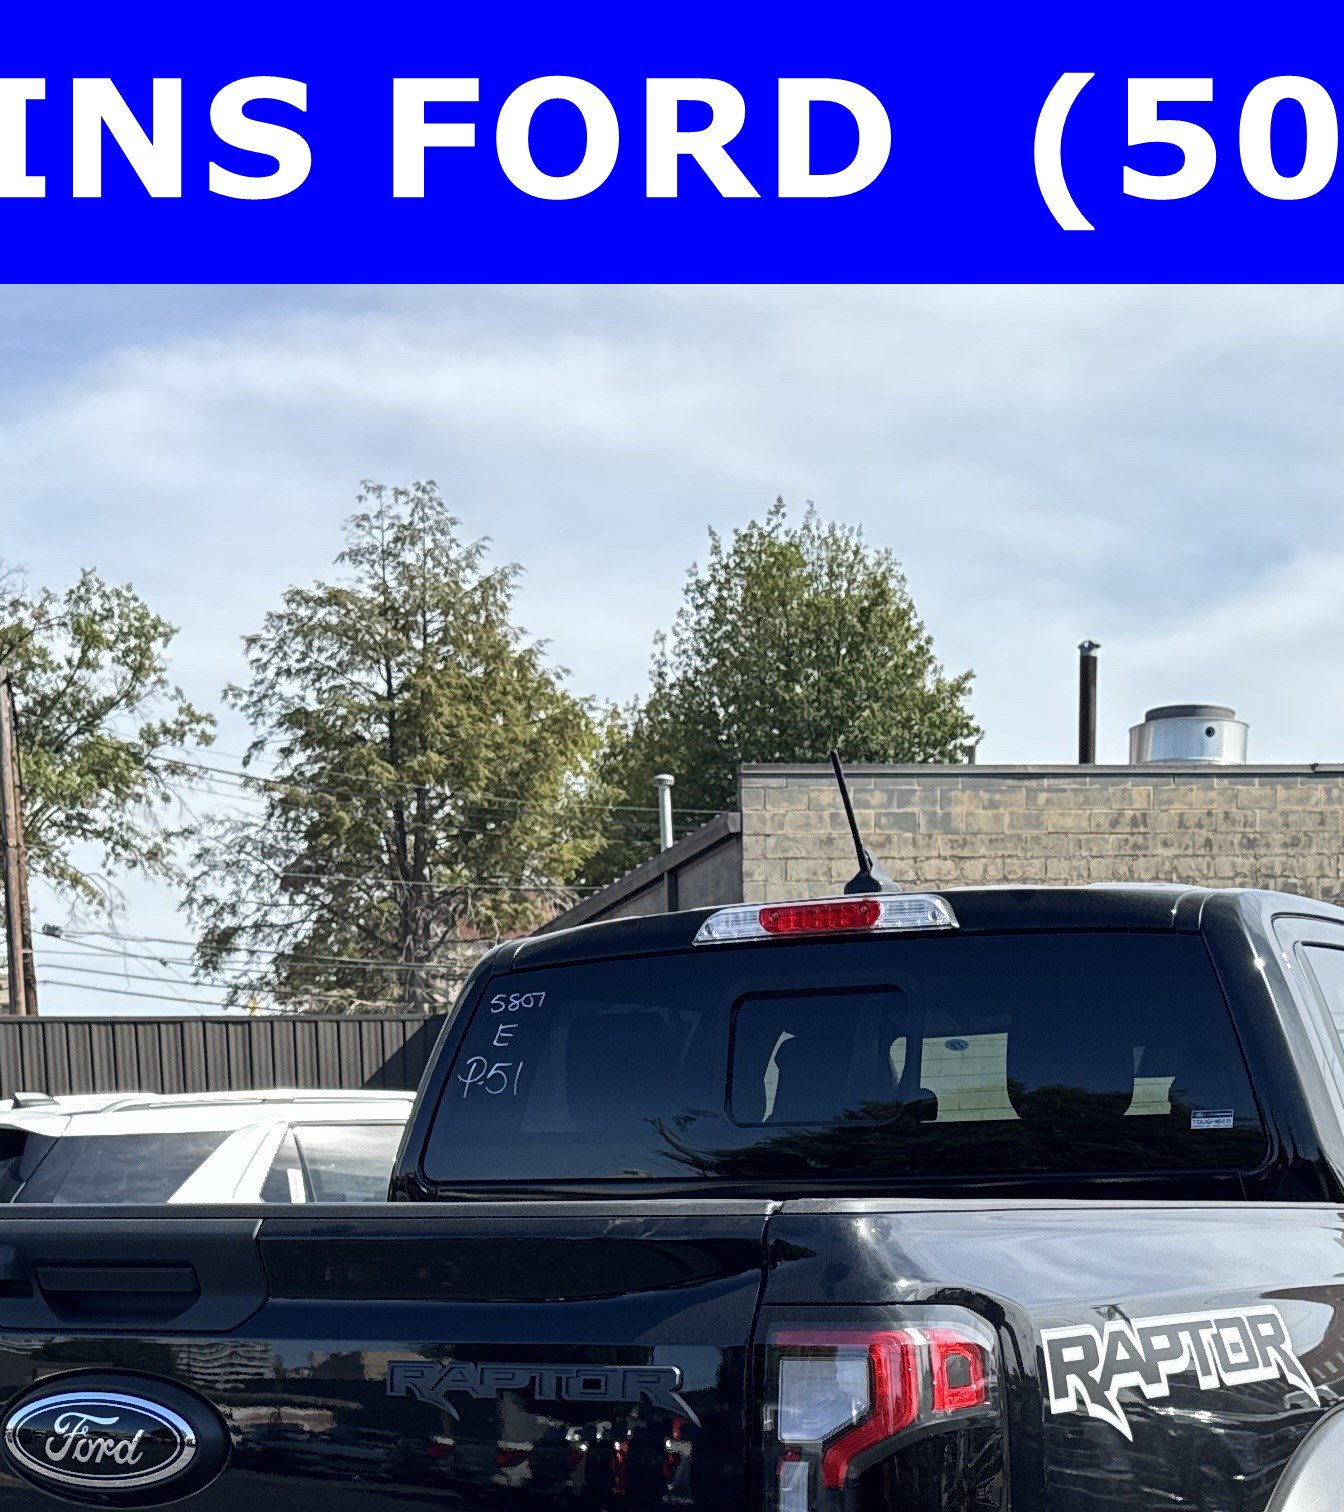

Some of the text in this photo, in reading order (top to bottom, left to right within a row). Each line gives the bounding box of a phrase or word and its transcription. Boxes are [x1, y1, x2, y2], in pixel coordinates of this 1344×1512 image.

[490, 991, 546, 1014] 5807
[493, 1023, 519, 1047] E
[387, 1360, 702, 1429] RAPTOR
[1040, 1305, 1320, 1442] RAPTOR
[45, 1411, 145, 1465] Ford
